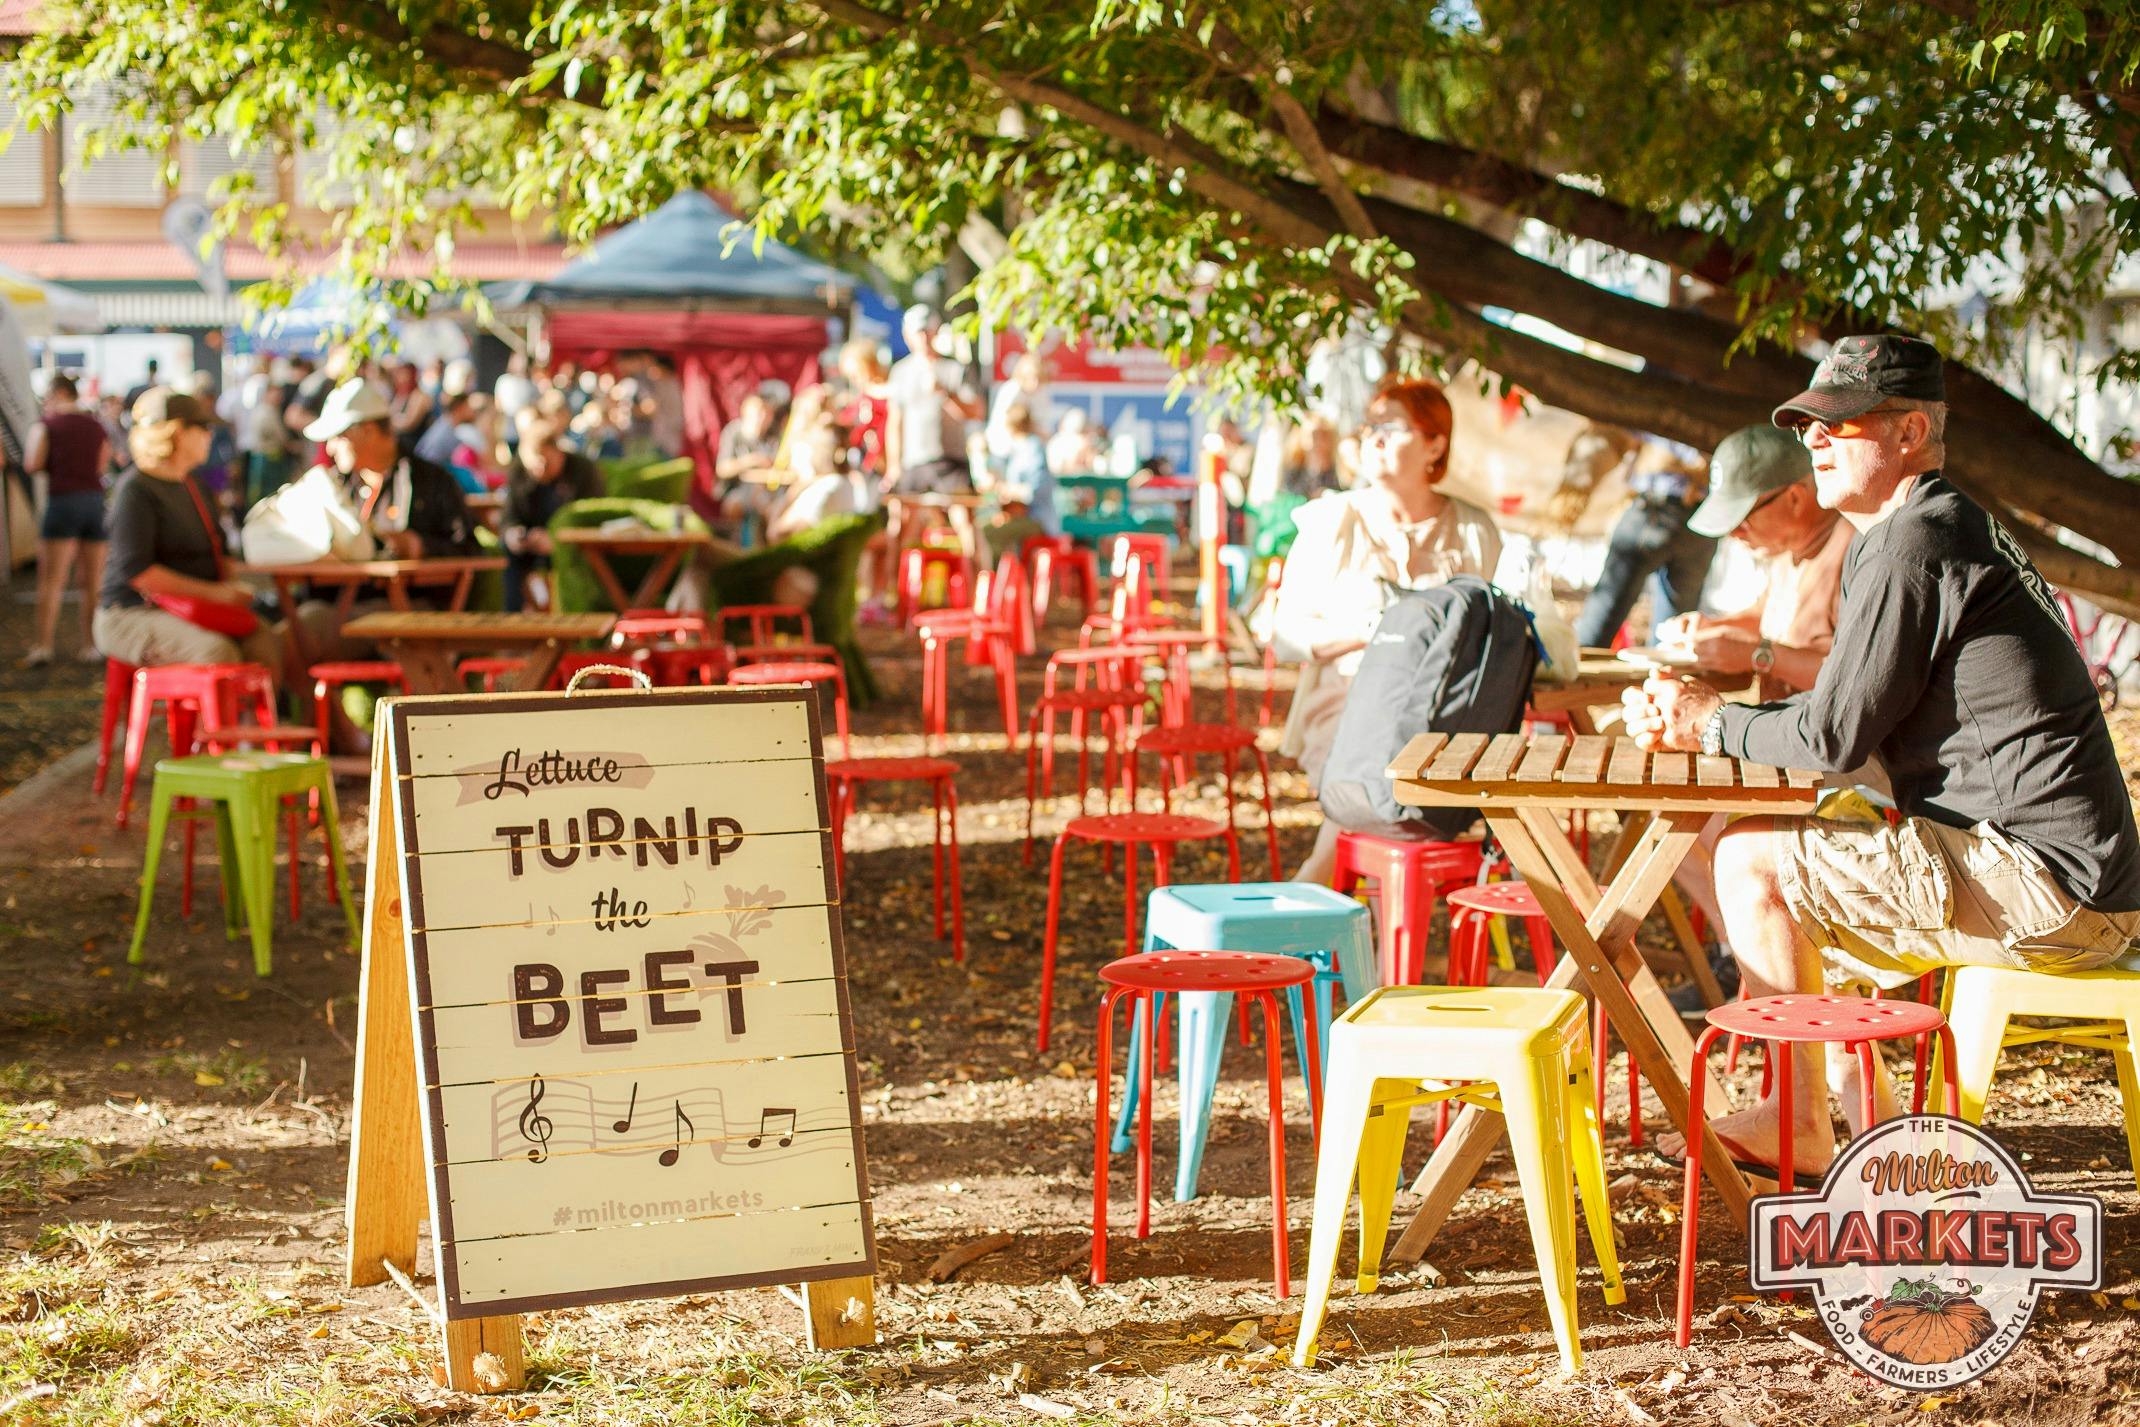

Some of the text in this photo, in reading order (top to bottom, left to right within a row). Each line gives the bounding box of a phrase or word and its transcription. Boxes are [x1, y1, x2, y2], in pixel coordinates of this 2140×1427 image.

[484, 748, 622, 800] Lettuce
[494, 806, 744, 879] TURNIP
[591, 887, 651, 932] the
[512, 950, 760, 1048] BEET
[552, 1190, 765, 1227] #miltonmarkets
